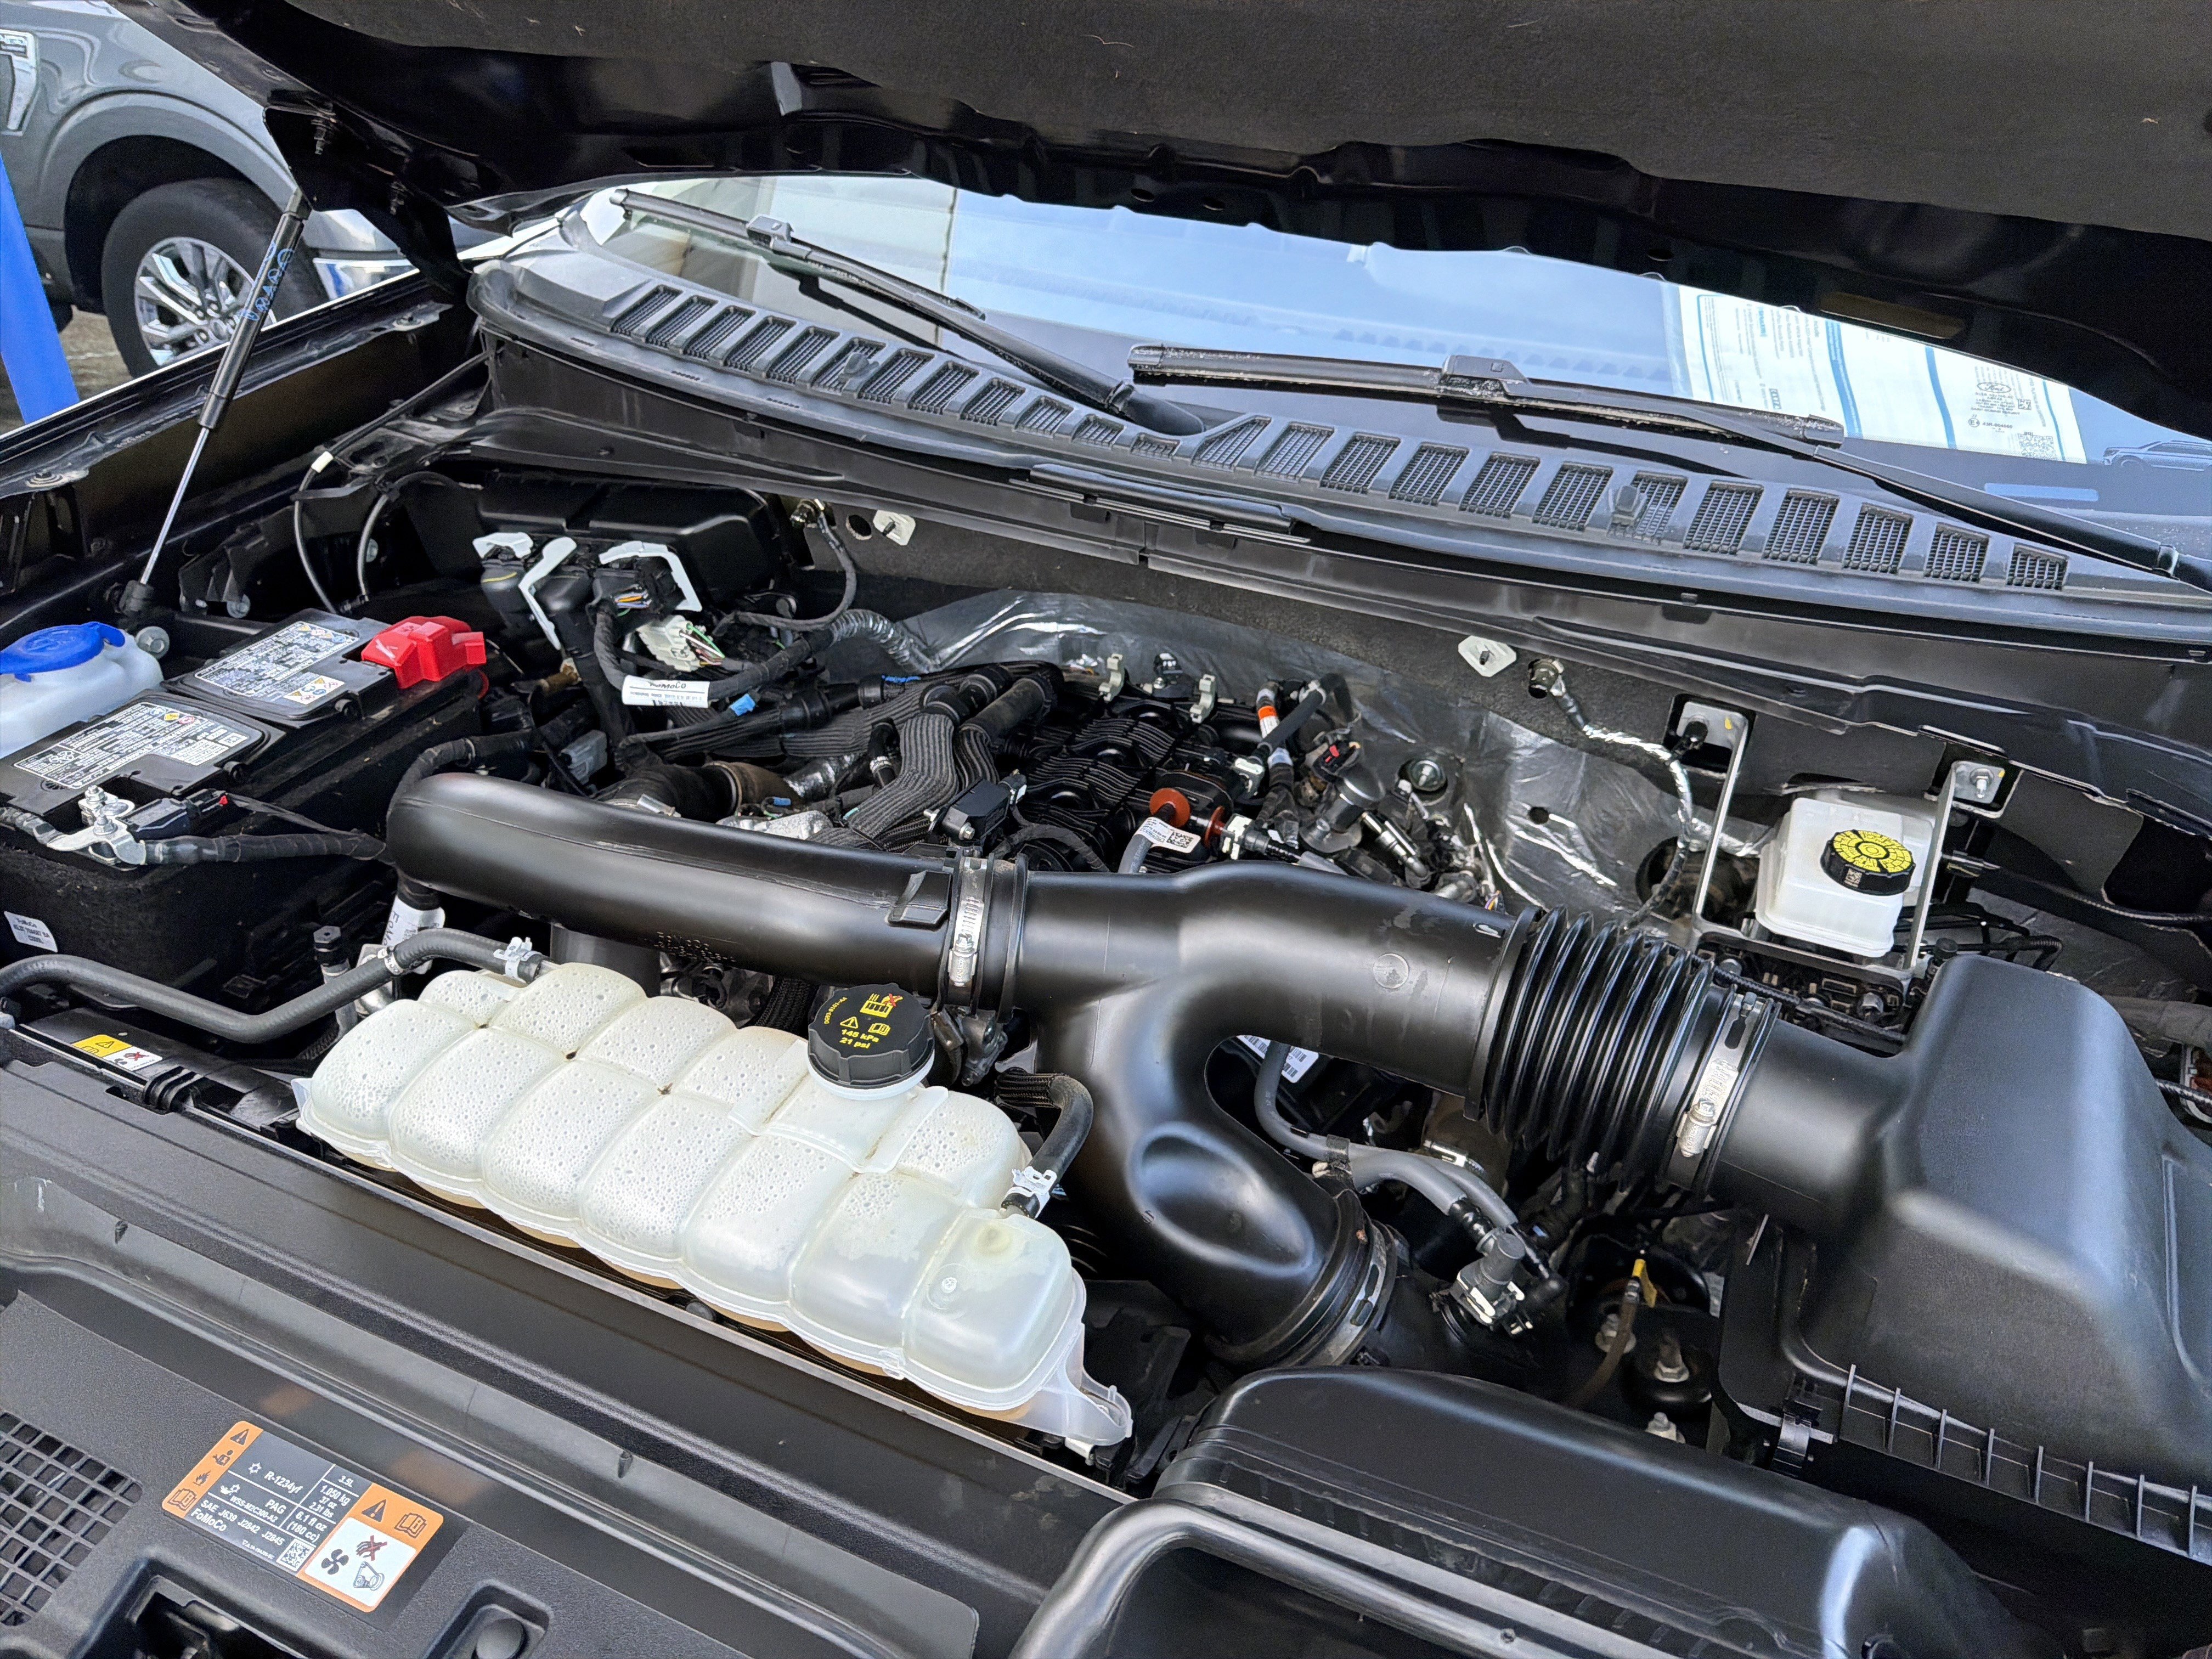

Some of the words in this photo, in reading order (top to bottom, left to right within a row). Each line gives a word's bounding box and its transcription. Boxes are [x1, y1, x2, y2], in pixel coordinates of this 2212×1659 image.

[842, 1029, 860, 1037] 145
[860, 1033, 879, 1042] kPa
[264, 1471, 303, 1494] R-1234yf
[338, 1475, 354, 1487] 3.5L
[319, 1496, 330, 1504] 37
[320, 1485, 341, 1499] 1.050
[339, 1494, 351, 1506] kg
[230, 1496, 278, 1523] WSS-M2C300-A2
[265, 1499, 287, 1514] PAG
[309, 1502, 325, 1513] 2.31
[323, 1508, 334, 1518] lbs
[191, 1509, 227, 1532] FoMoCo
[201, 1500, 219, 1513] SAE
[218, 1509, 238, 1522] J639
[238, 1520, 261, 1534] J2842
[262, 1531, 285, 1546] J2845
[295, 1511, 310, 1522] 6.1
[308, 1517, 318, 1526] fl
[315, 1522, 328, 1532] oz
[286, 1521, 306, 1535] (180
[305, 1531, 320, 1543] cc)
